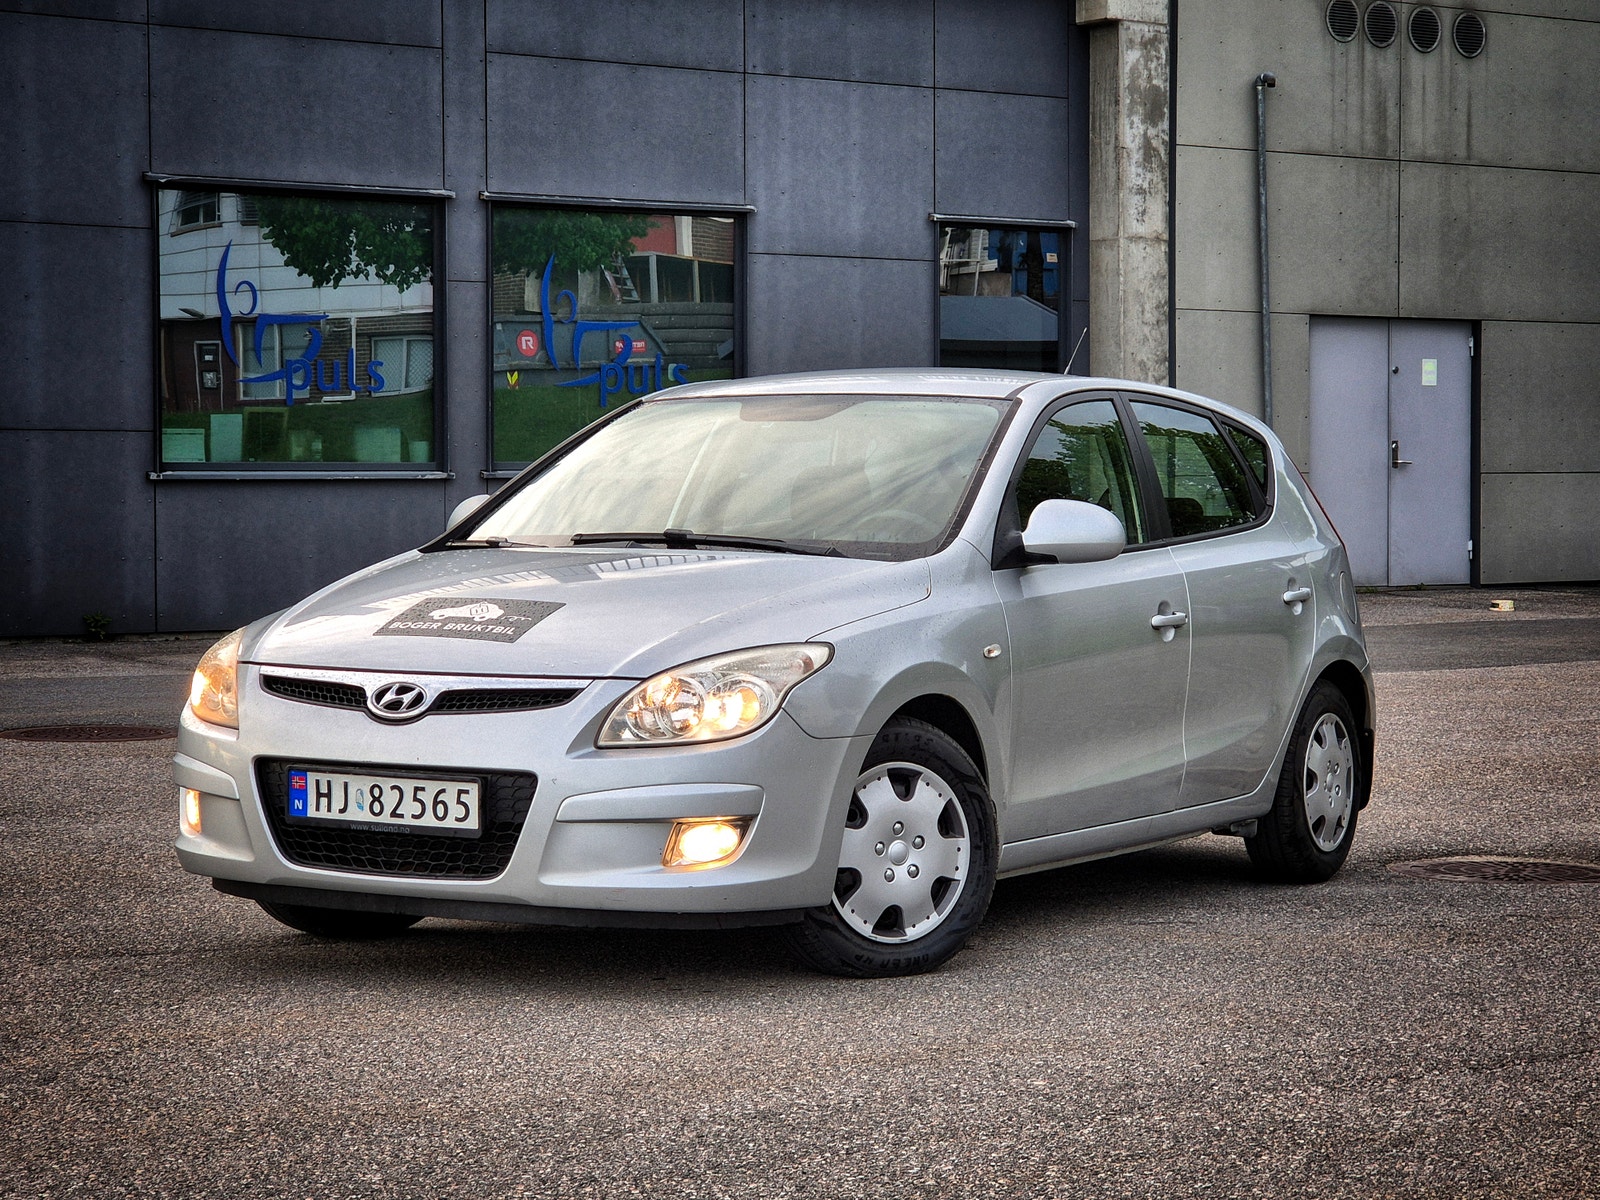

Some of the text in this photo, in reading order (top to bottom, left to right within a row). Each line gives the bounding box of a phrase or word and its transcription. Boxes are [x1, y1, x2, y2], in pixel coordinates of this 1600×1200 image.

[285, 347, 385, 406] puls
[600, 351, 689, 408] puls
[443, 622, 516, 635] BRUKTBIL
[294, 798, 303, 810] N
[314, 778, 471, 823] HJ 82565
